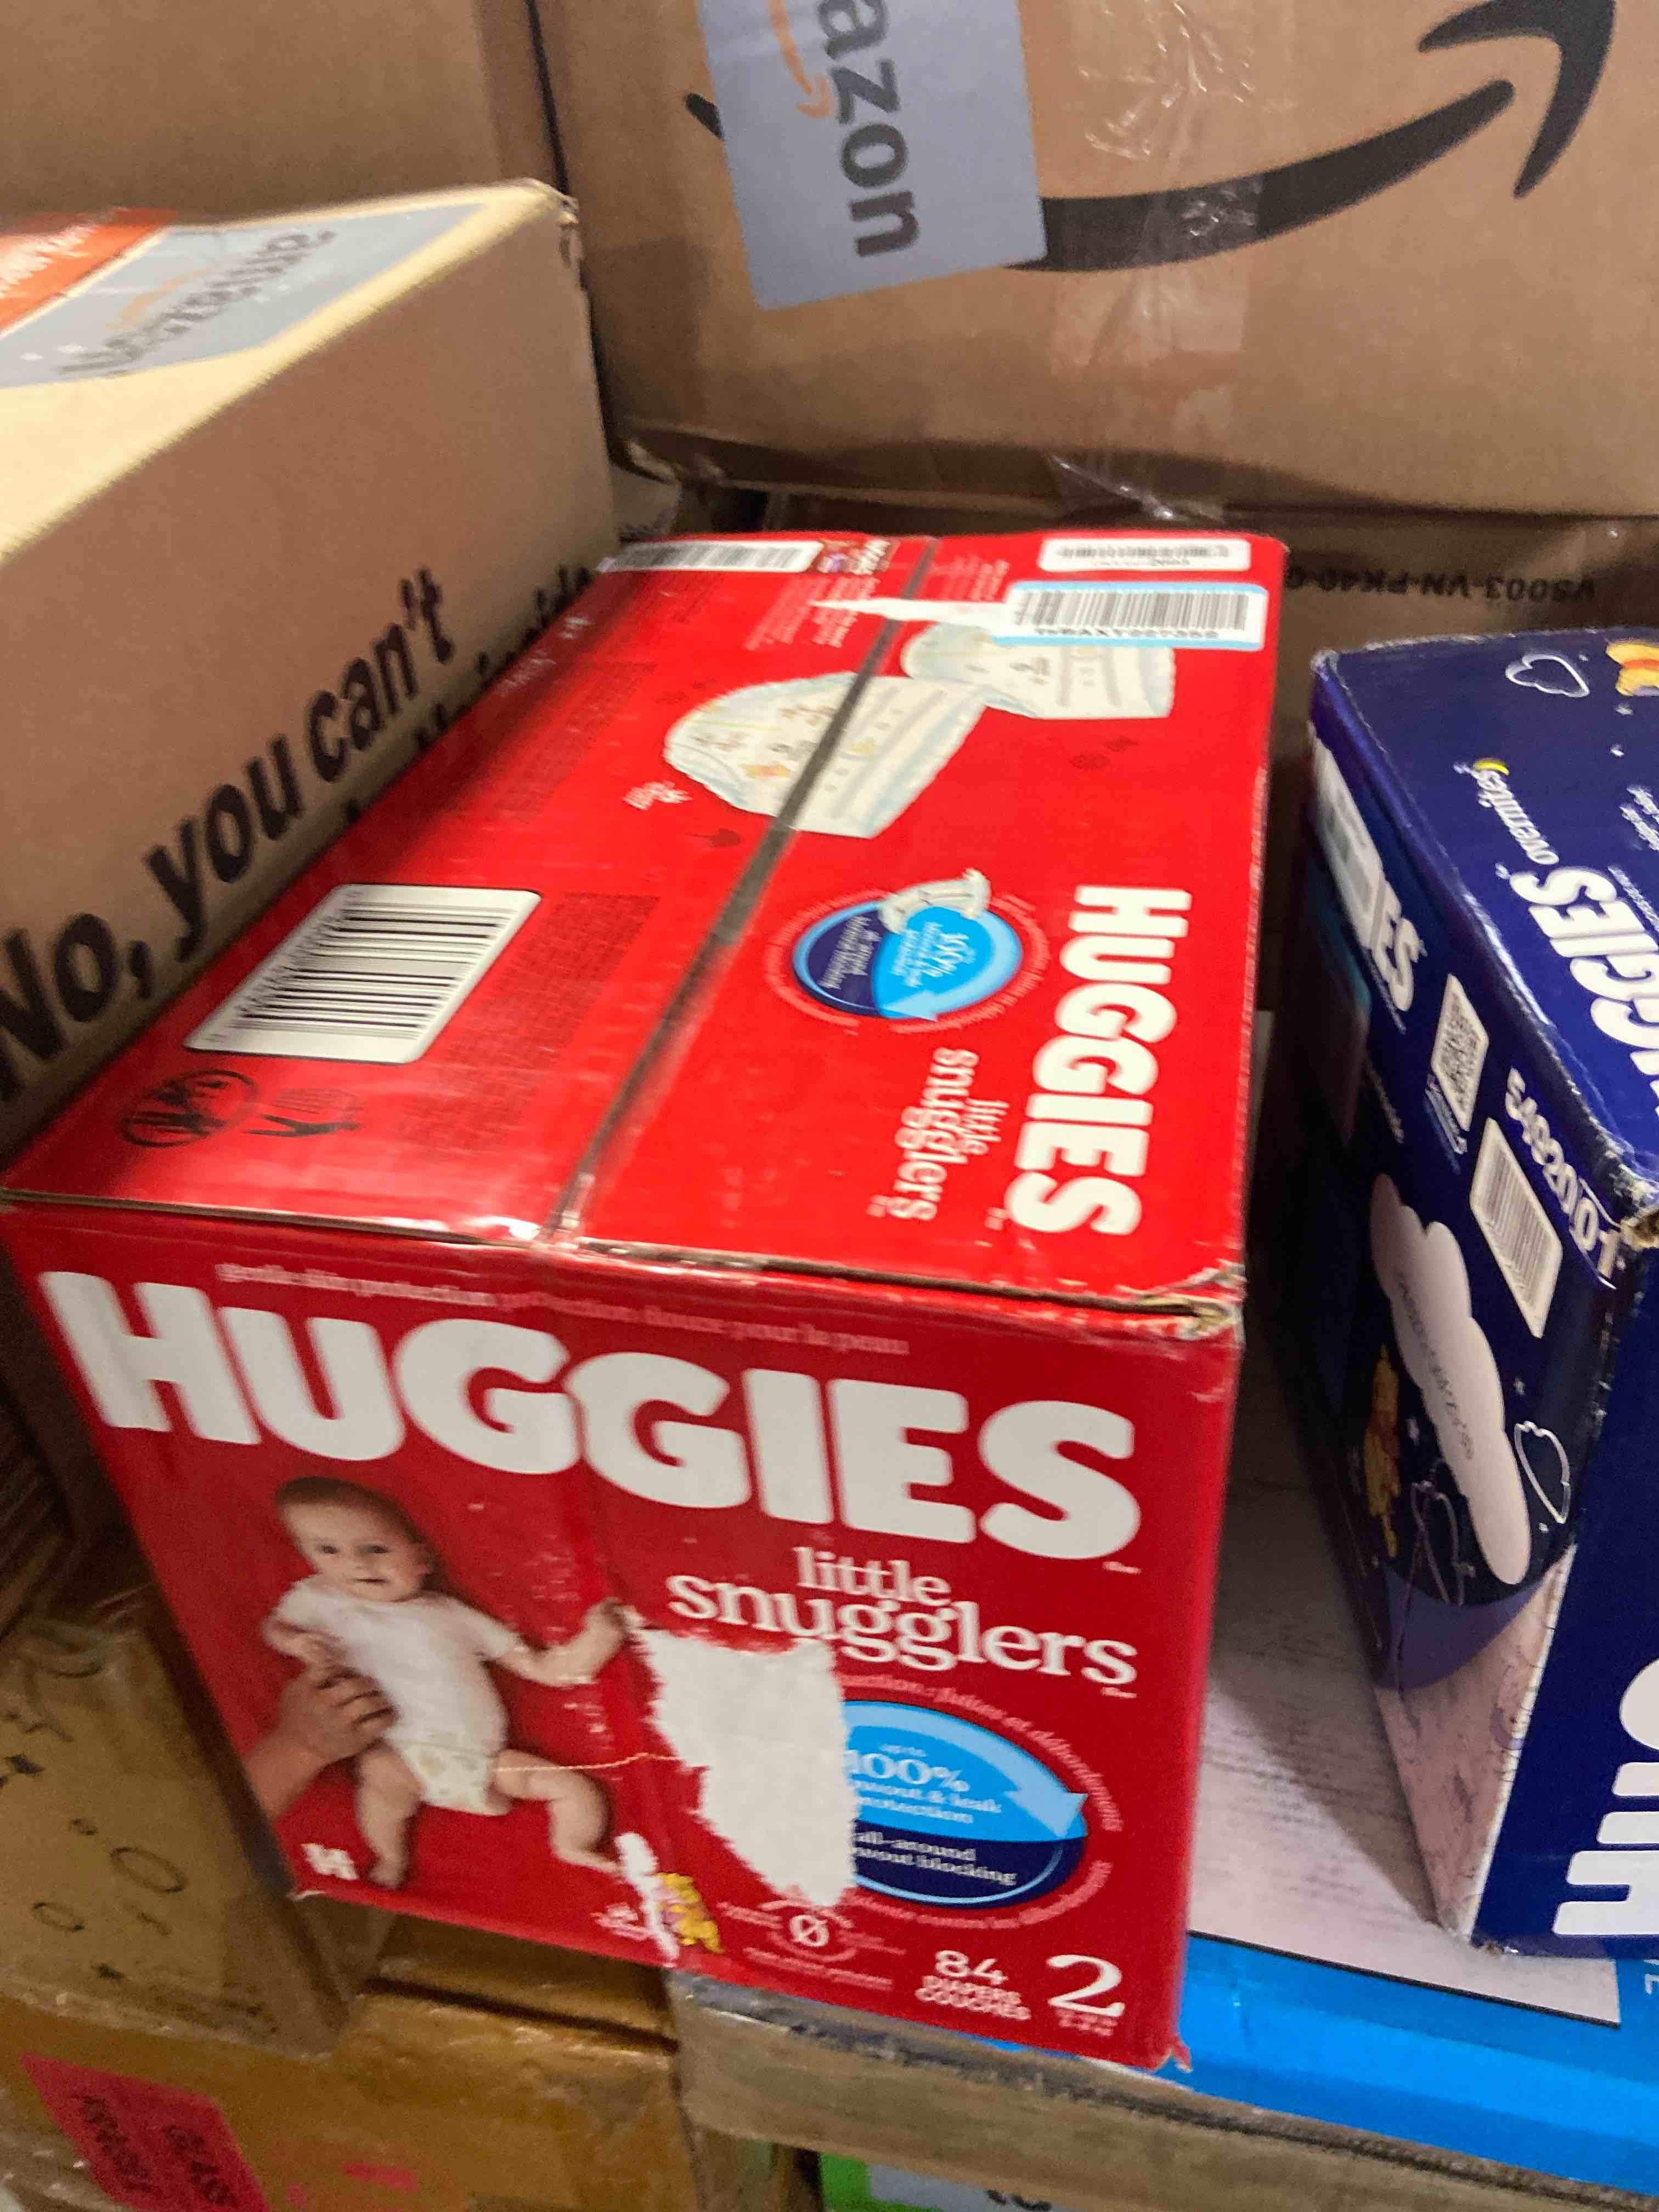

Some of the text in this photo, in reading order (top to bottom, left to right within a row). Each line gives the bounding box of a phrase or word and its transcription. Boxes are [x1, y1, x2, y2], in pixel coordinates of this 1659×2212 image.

[144, 733, 303, 963] you
[306, 566, 454, 783] can't
[1003, 884, 1194, 1237] HUGGIES
[38, 1268, 1142, 1561] HUGGIES
[793, 1545, 955, 1607] little
[664, 1572, 1138, 1687] snugglers
[844, 1748, 970, 1792] 100%
[934, 1949, 1009, 1986] 84
[1046, 1954, 1126, 2018] 2
